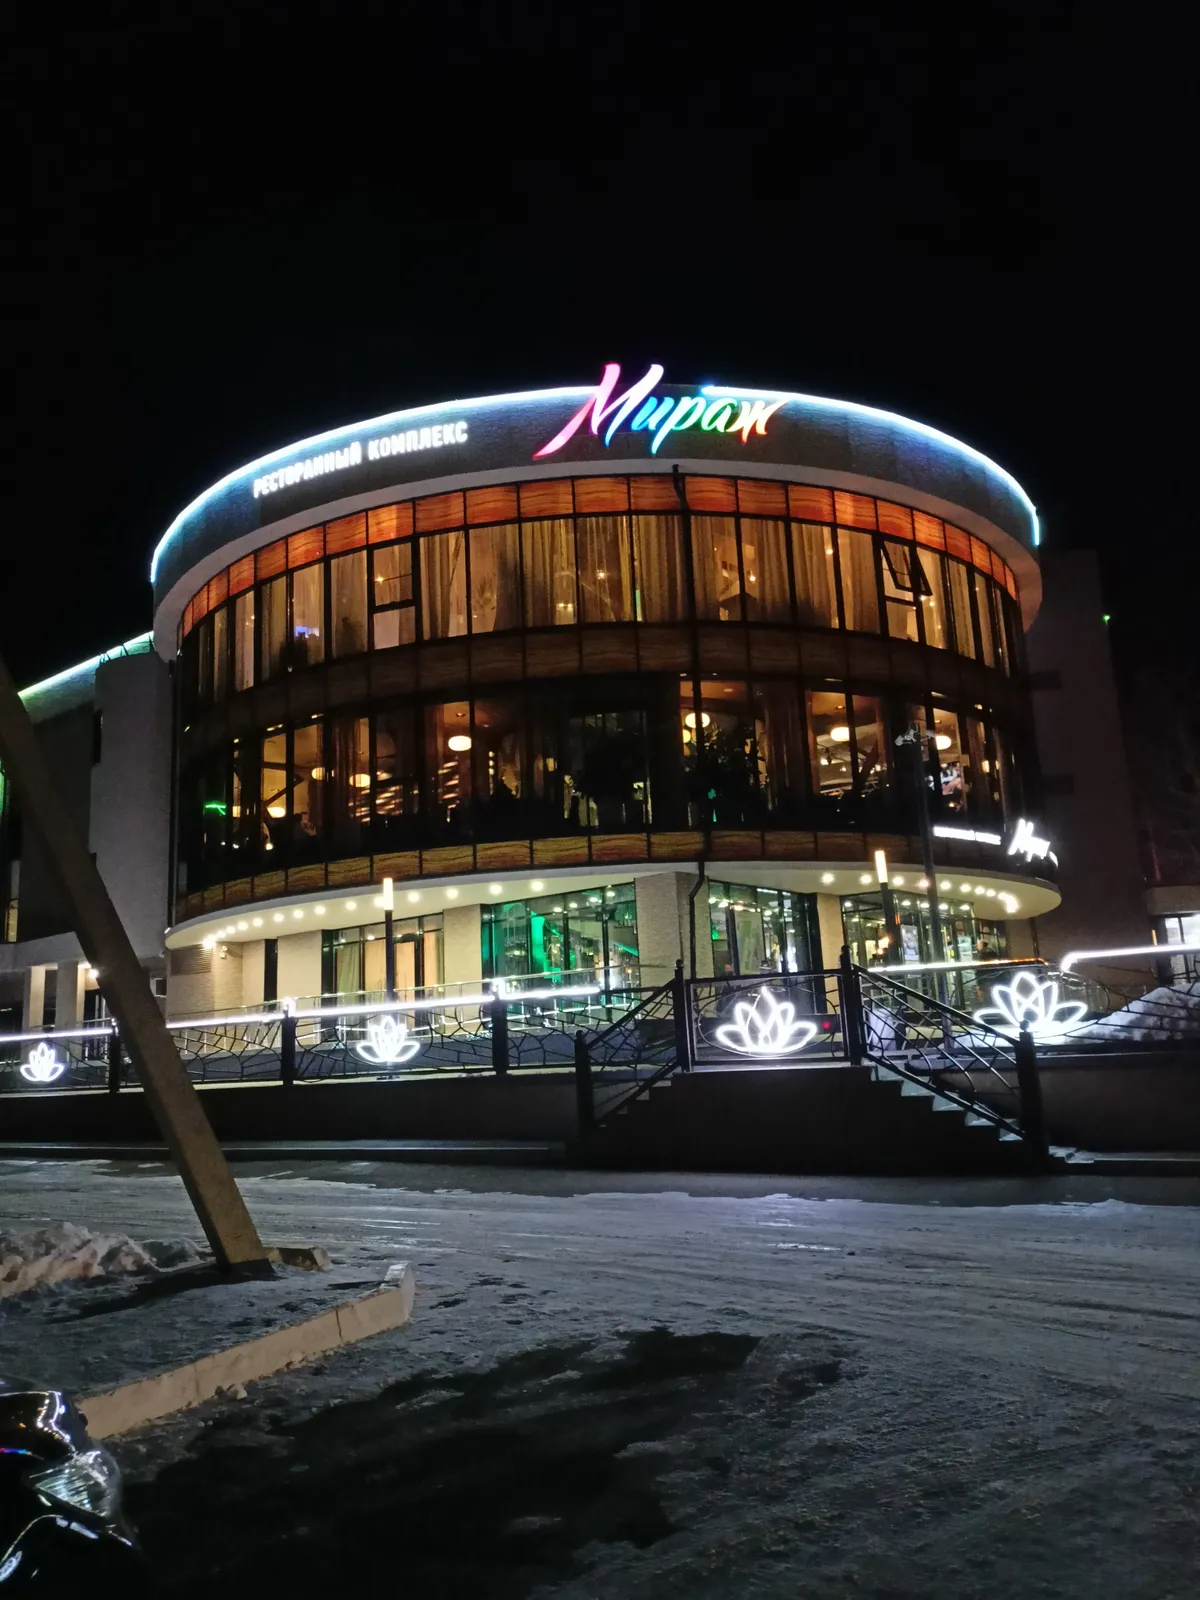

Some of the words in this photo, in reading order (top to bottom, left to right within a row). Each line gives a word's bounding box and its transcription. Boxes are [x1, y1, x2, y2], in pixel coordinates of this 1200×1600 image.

[532, 363, 788, 459] Мираж
[252, 440, 362, 498] РЕСТОРАННЫЙ
[367, 420, 469, 461] КОМПЛЕКС
